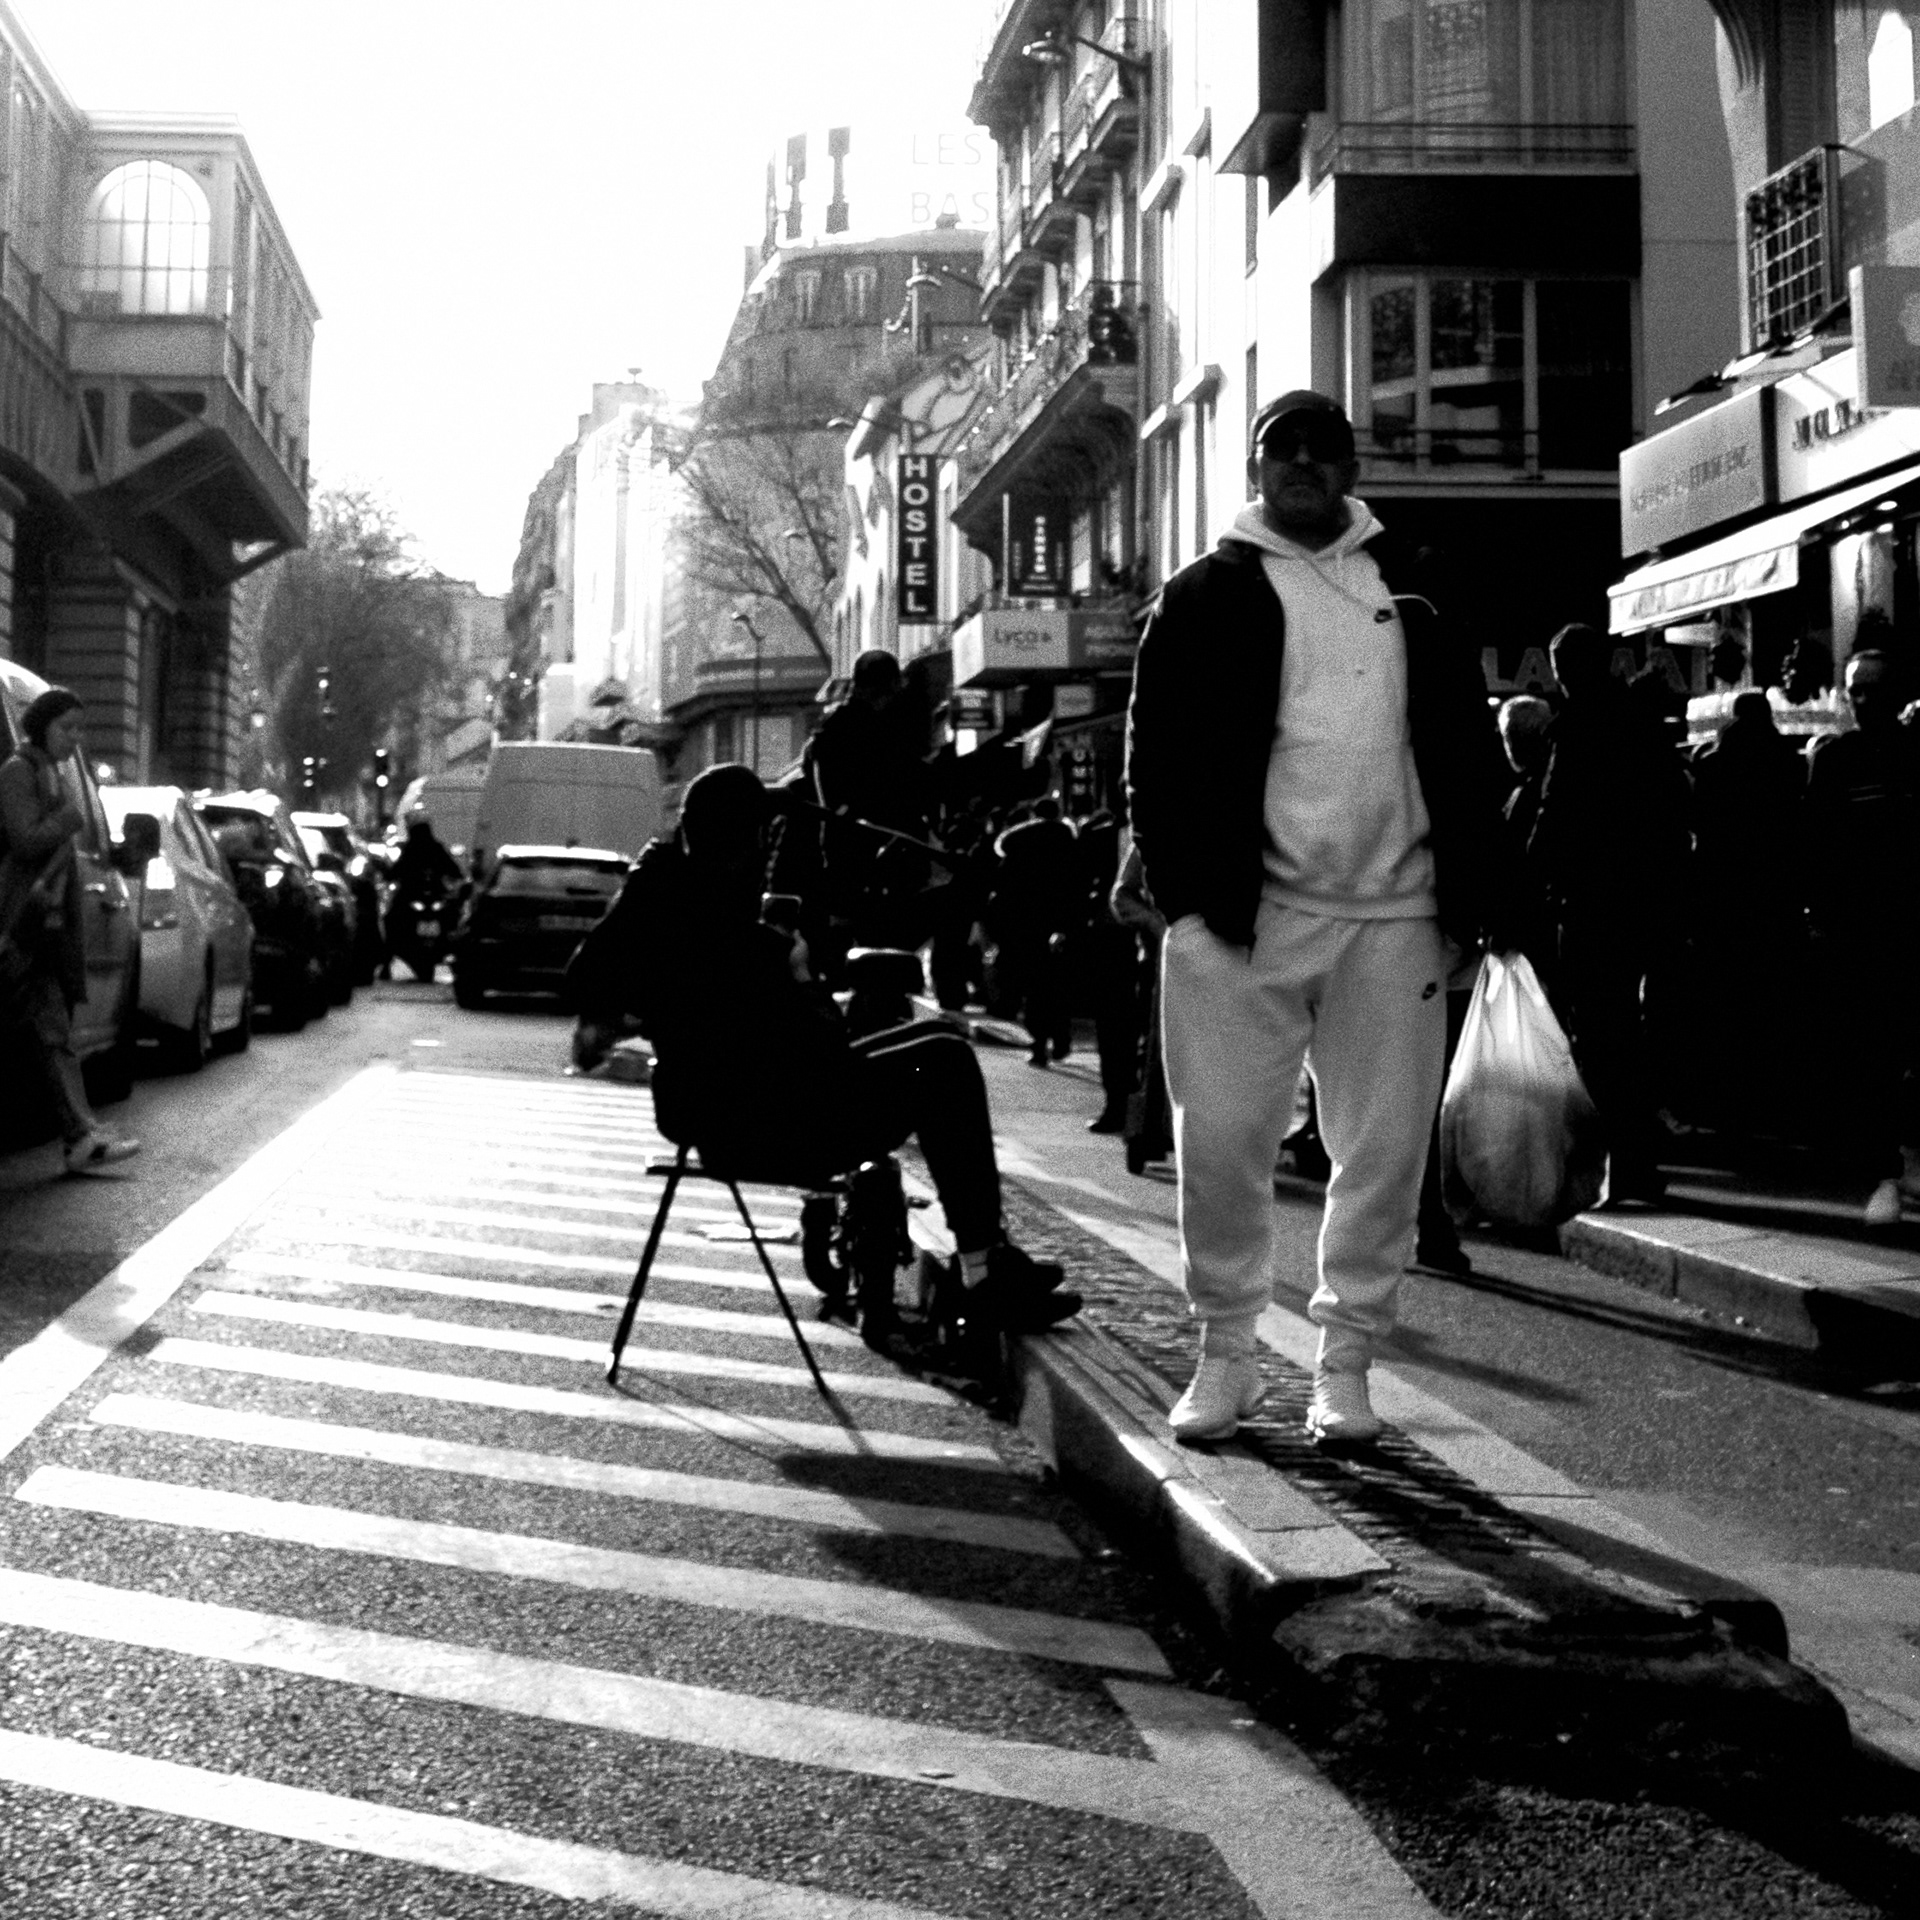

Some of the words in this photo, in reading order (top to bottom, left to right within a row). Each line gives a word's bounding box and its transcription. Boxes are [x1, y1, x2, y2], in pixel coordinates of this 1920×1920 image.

[912, 133, 981, 165] LES
[911, 192, 989, 224] BAS
[903, 456, 930, 614] HOSTEL
